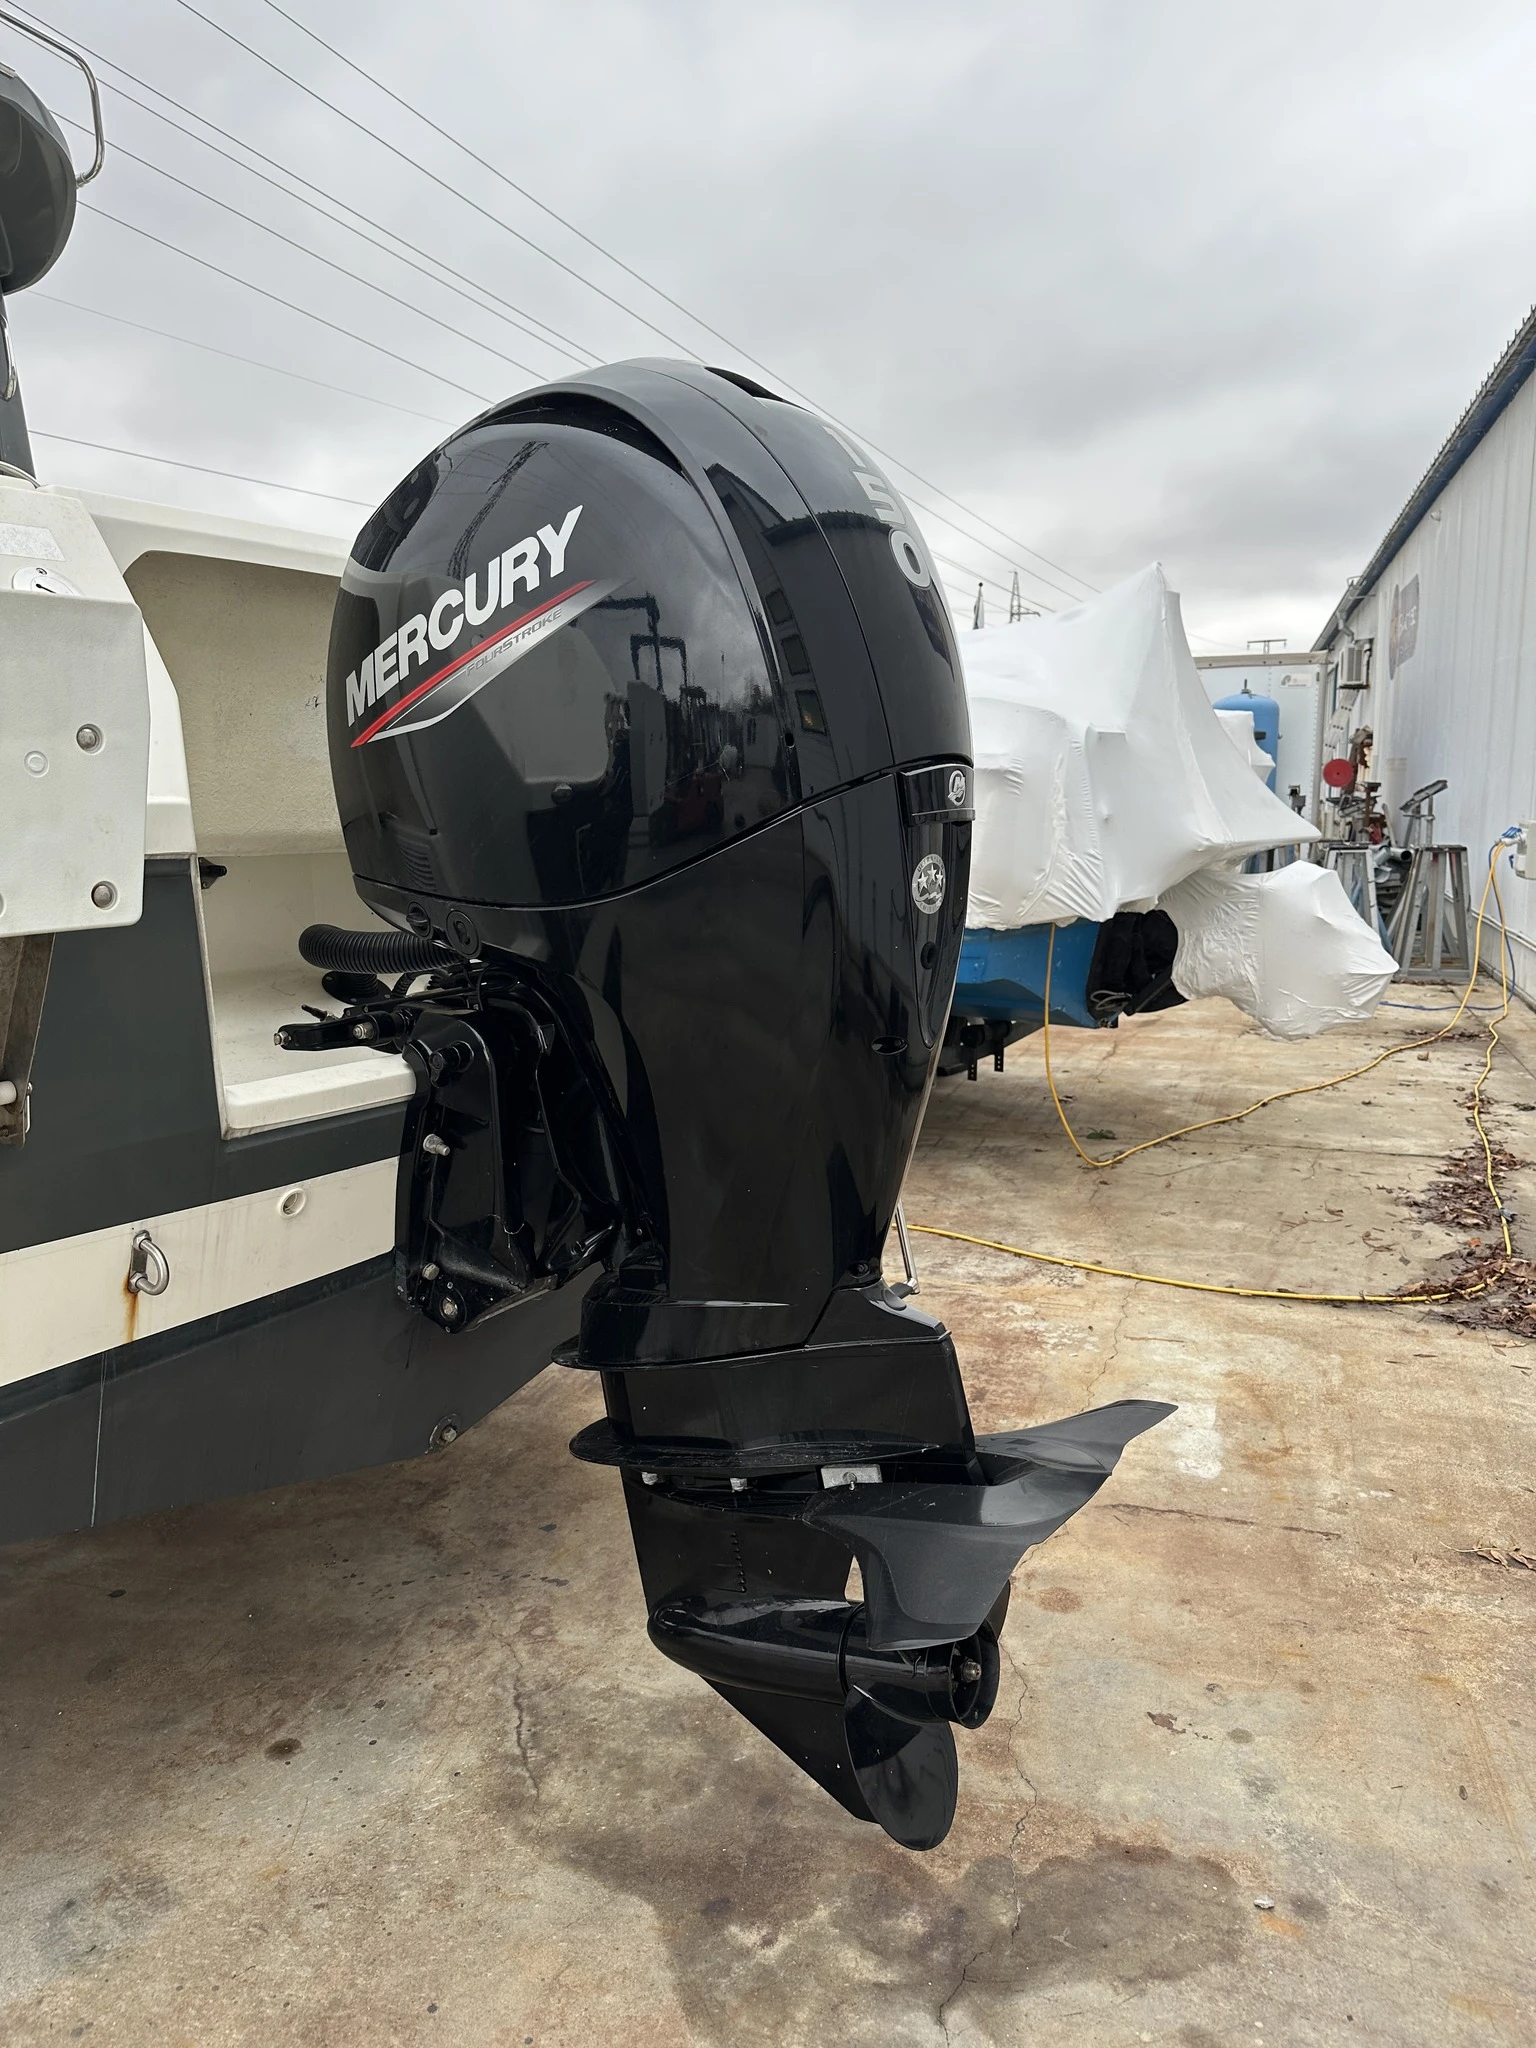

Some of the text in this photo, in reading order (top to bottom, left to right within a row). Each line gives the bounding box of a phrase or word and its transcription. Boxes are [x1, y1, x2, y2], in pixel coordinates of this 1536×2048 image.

[821, 425, 931, 589] 150
[346, 504, 584, 727] MERCURY
[465, 608, 563, 677] FOURSTROKE
